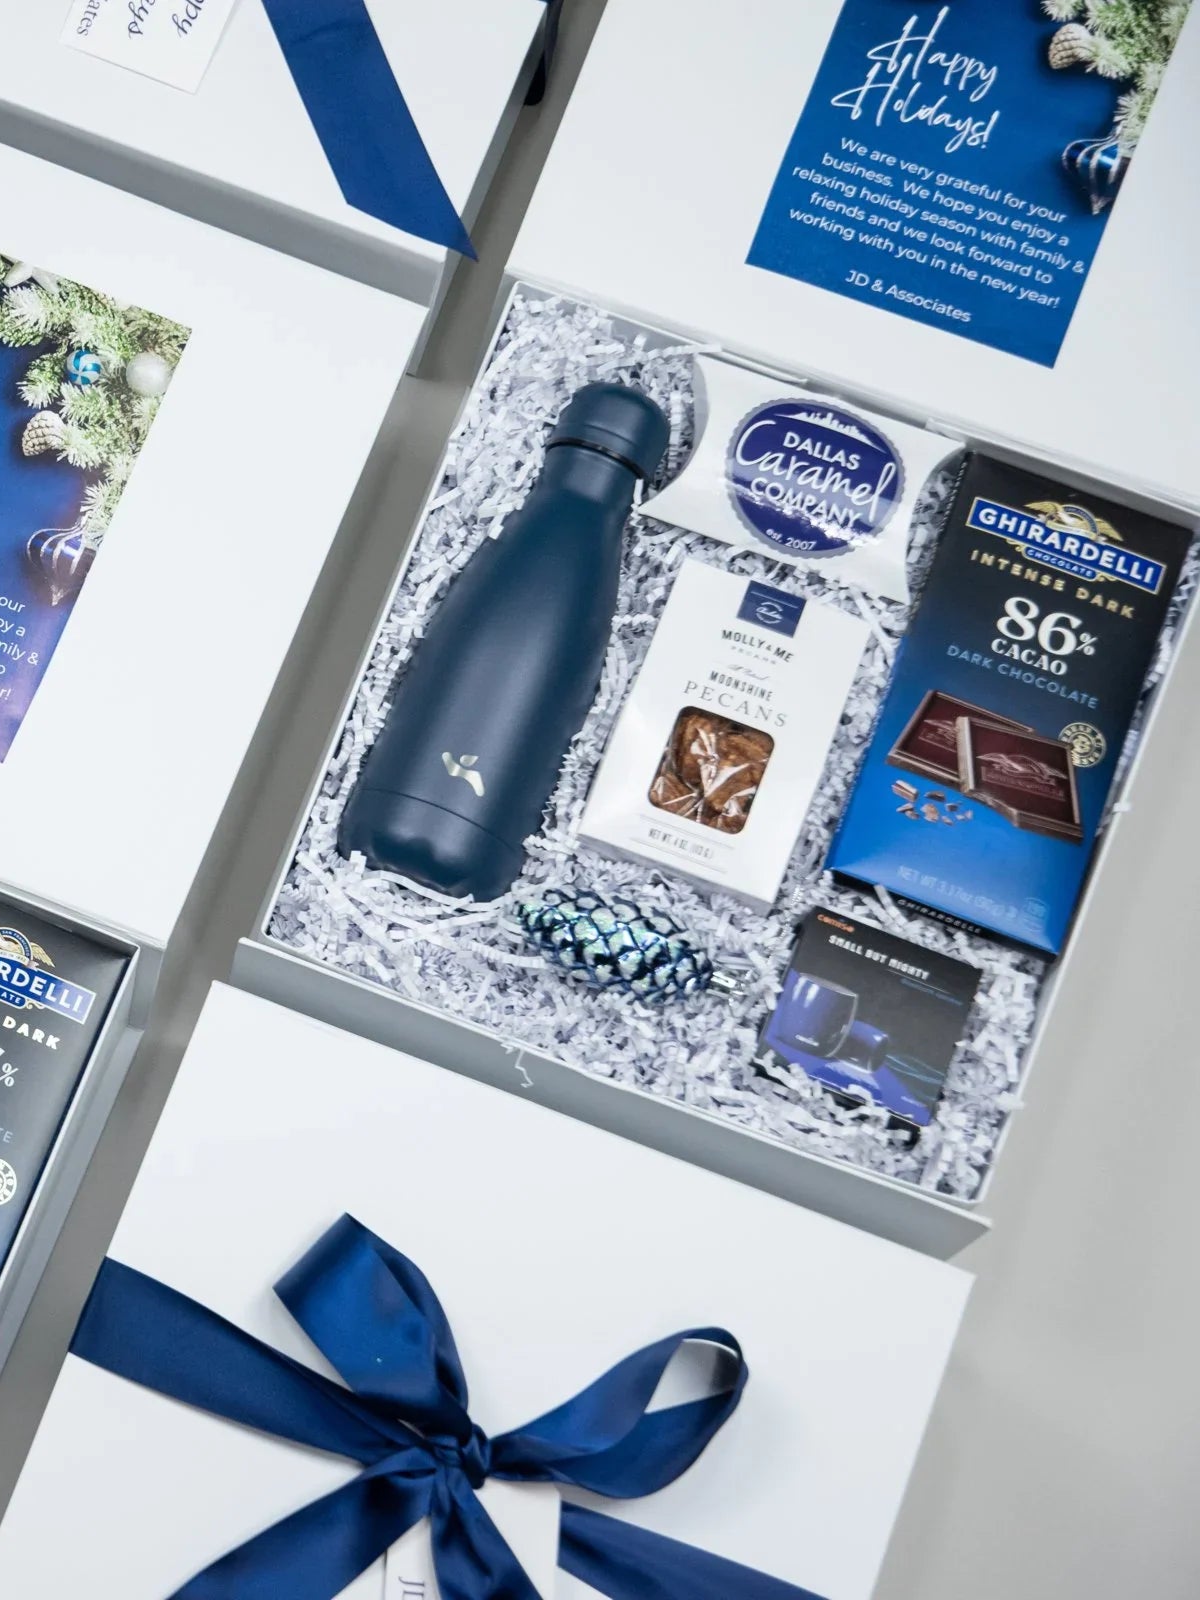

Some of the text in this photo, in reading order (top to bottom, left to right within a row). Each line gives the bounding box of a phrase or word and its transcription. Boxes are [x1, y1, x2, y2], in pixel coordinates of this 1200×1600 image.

[867, 6, 997, 102] Happy
[831, 52, 999, 153] Holidays!
[822, 153, 1069, 246] business. We hope you enjoy a
[841, 137, 1067, 224] We are very grateful for your
[792, 165, 1084, 274] relaxing holiday season with family &
[809, 192, 1053, 284] friends and we look forward to
[789, 208, 1060, 309] working with you in the new year!
[845, 270, 972, 323] JD & Associates
[736, 420, 896, 523] Caramel
[783, 431, 860, 471] DALLAS
[751, 477, 862, 528] COMPANY
[765, 528, 817, 551] est. 2007
[979, 508, 1154, 584] GHIRARDELLI
[1027, 548, 1093, 578] CHOCOLATE
[971, 550, 1135, 619] INTENSE DARK
[17, 625, 26, 637] a
[721, 629, 765, 649] MOLLY
[773, 644, 794, 663] ME
[996, 596, 1098, 656] 86%
[27, 651, 39, 666] &
[946, 645, 1099, 709] DARK CHOCOLATE
[991, 638, 1067, 675] CACAO
[683, 680, 788, 727] PECANS
[708, 670, 773, 702] MOONSHINE
[828, 934, 929, 980] SMALL BUT MIGHTY
[2, 1016, 61, 1050] DARK
